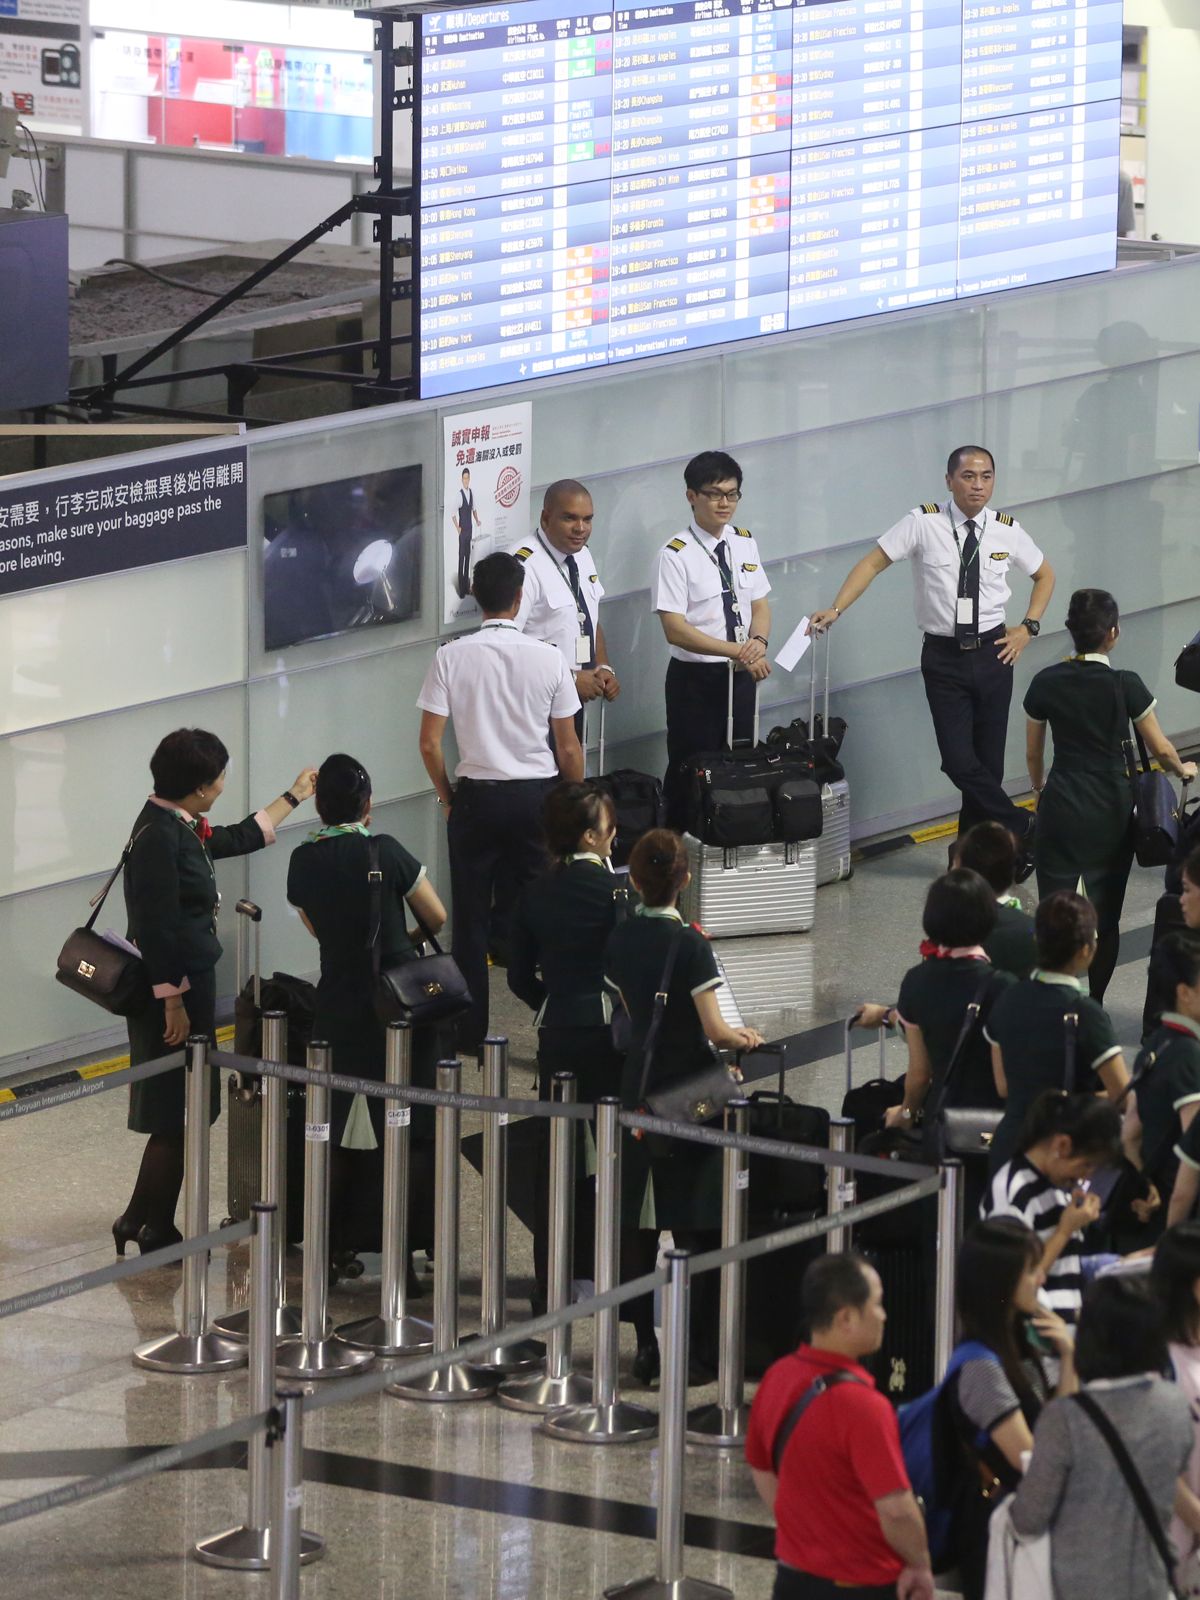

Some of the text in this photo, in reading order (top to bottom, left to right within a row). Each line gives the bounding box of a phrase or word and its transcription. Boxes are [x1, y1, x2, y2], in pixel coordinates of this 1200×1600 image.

[615, 56, 630, 67] 19:20
[422, 83, 438, 94] 18:40
[421, 212, 437, 223] 19:00
[612, 264, 627, 275] 19:40
[654, 255, 678, 268] Francisco
[421, 297, 437, 308] 19:10
[612, 305, 626, 316] 19:40
[653, 296, 677, 309] Francisco
[421, 339, 437, 350] 19:10
[451, 424, 490, 447] 誠實申報
[36, 526, 68, 545] make
[70, 520, 95, 538] sure
[97, 517, 122, 538] your
[124, 507, 174, 529] baggage
[177, 502, 202, 521] pass
[204, 495, 222, 511] the
[20, 549, 65, 569] leaving.
[15, 1099, 41, 1113] Taoyuan
[41, 1088, 81, 1106] International
[81, 1081, 104, 1094] Airport
[330, 1076, 358, 1089] Taiwan
[360, 1080, 394, 1096] Taoyuan
[395, 1086, 449, 1102] International
[449, 1095, 480, 1108] Airport
[672, 1123, 820, 1160] Taiwan Taoyuan International Airport
